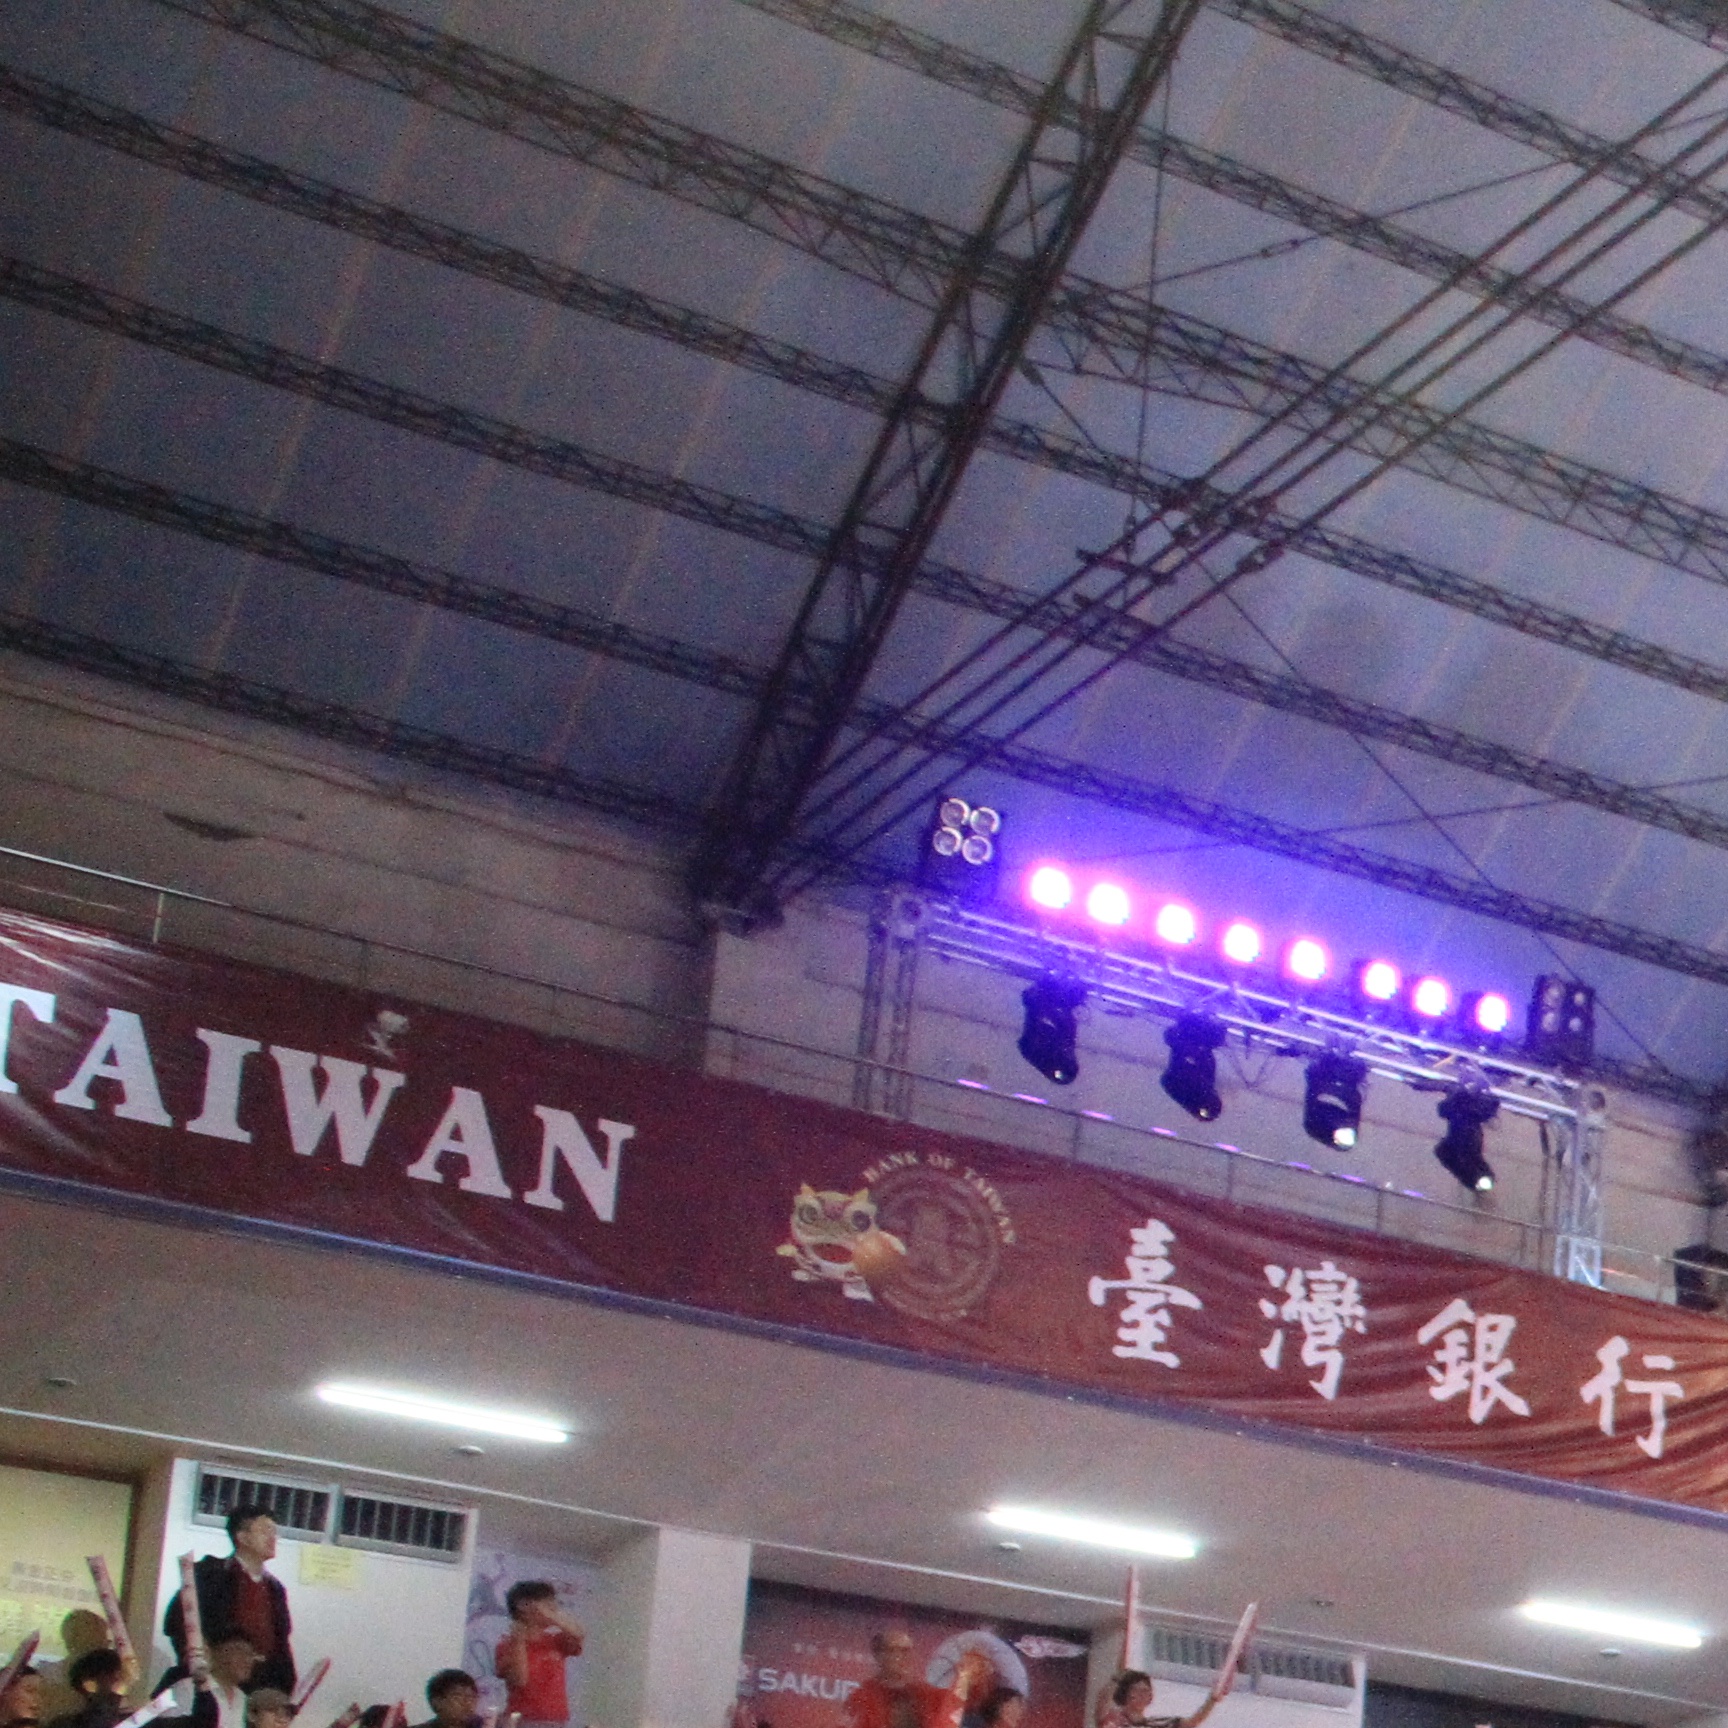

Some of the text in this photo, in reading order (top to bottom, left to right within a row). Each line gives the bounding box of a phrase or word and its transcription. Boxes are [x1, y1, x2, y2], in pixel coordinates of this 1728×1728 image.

[0, 984, 635, 1222] TAIWAN
[1088, 1219, 1685, 1459] 臺灣銀行
